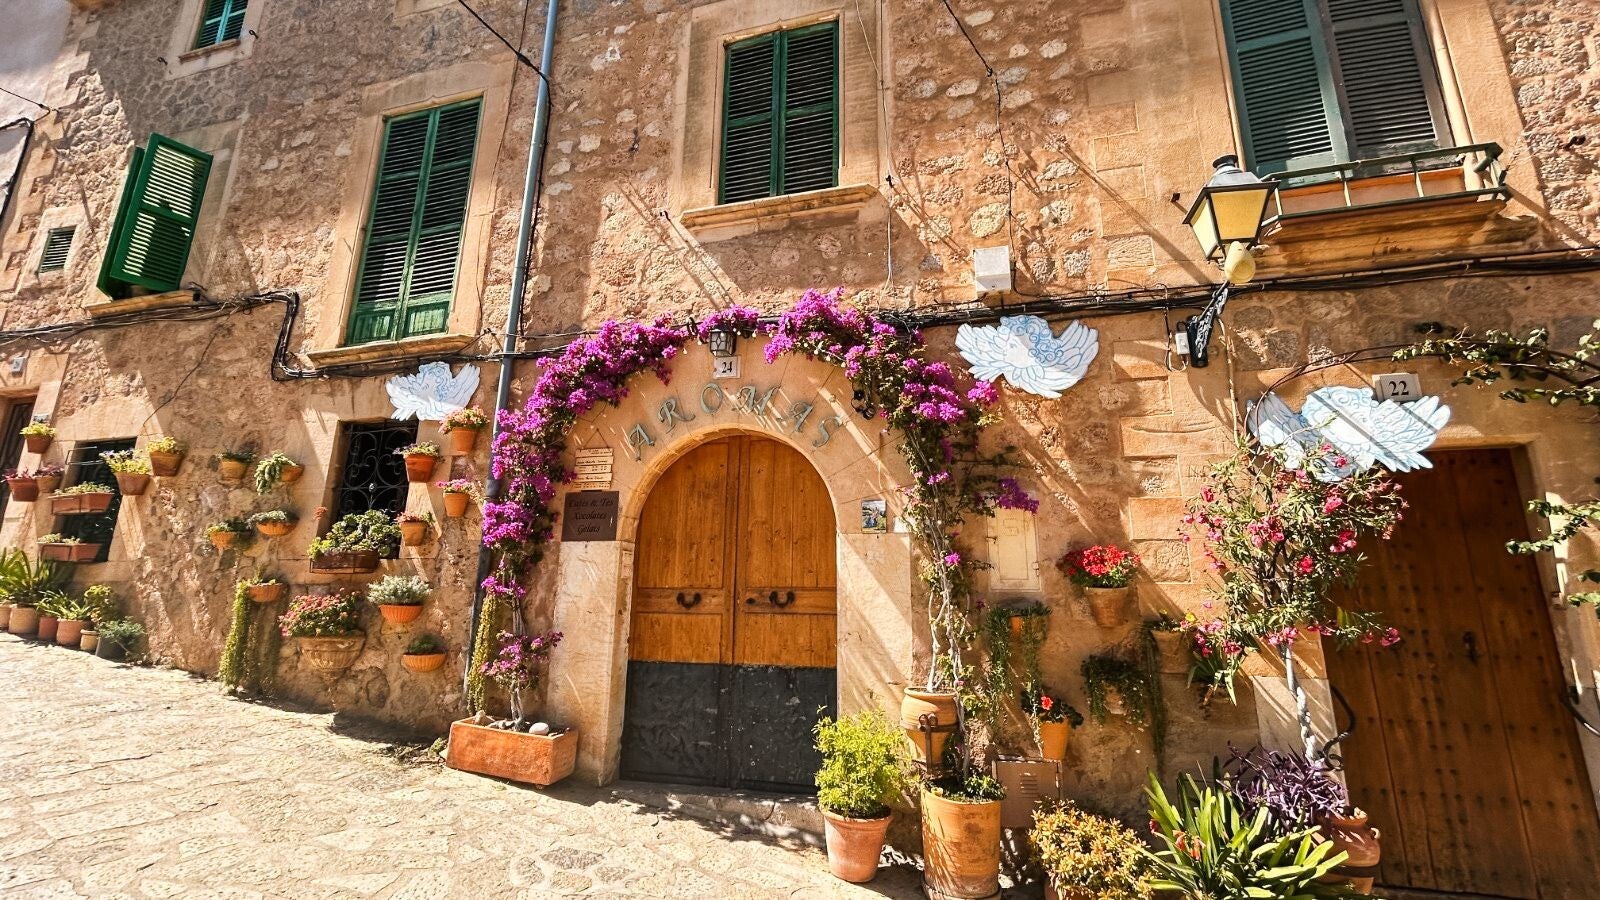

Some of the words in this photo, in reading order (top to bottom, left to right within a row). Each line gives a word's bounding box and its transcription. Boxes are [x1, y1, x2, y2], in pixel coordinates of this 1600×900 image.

[722, 361, 733, 373] 24
[1389, 380, 1409, 396] 22
[628, 382, 846, 463] AROMAS
